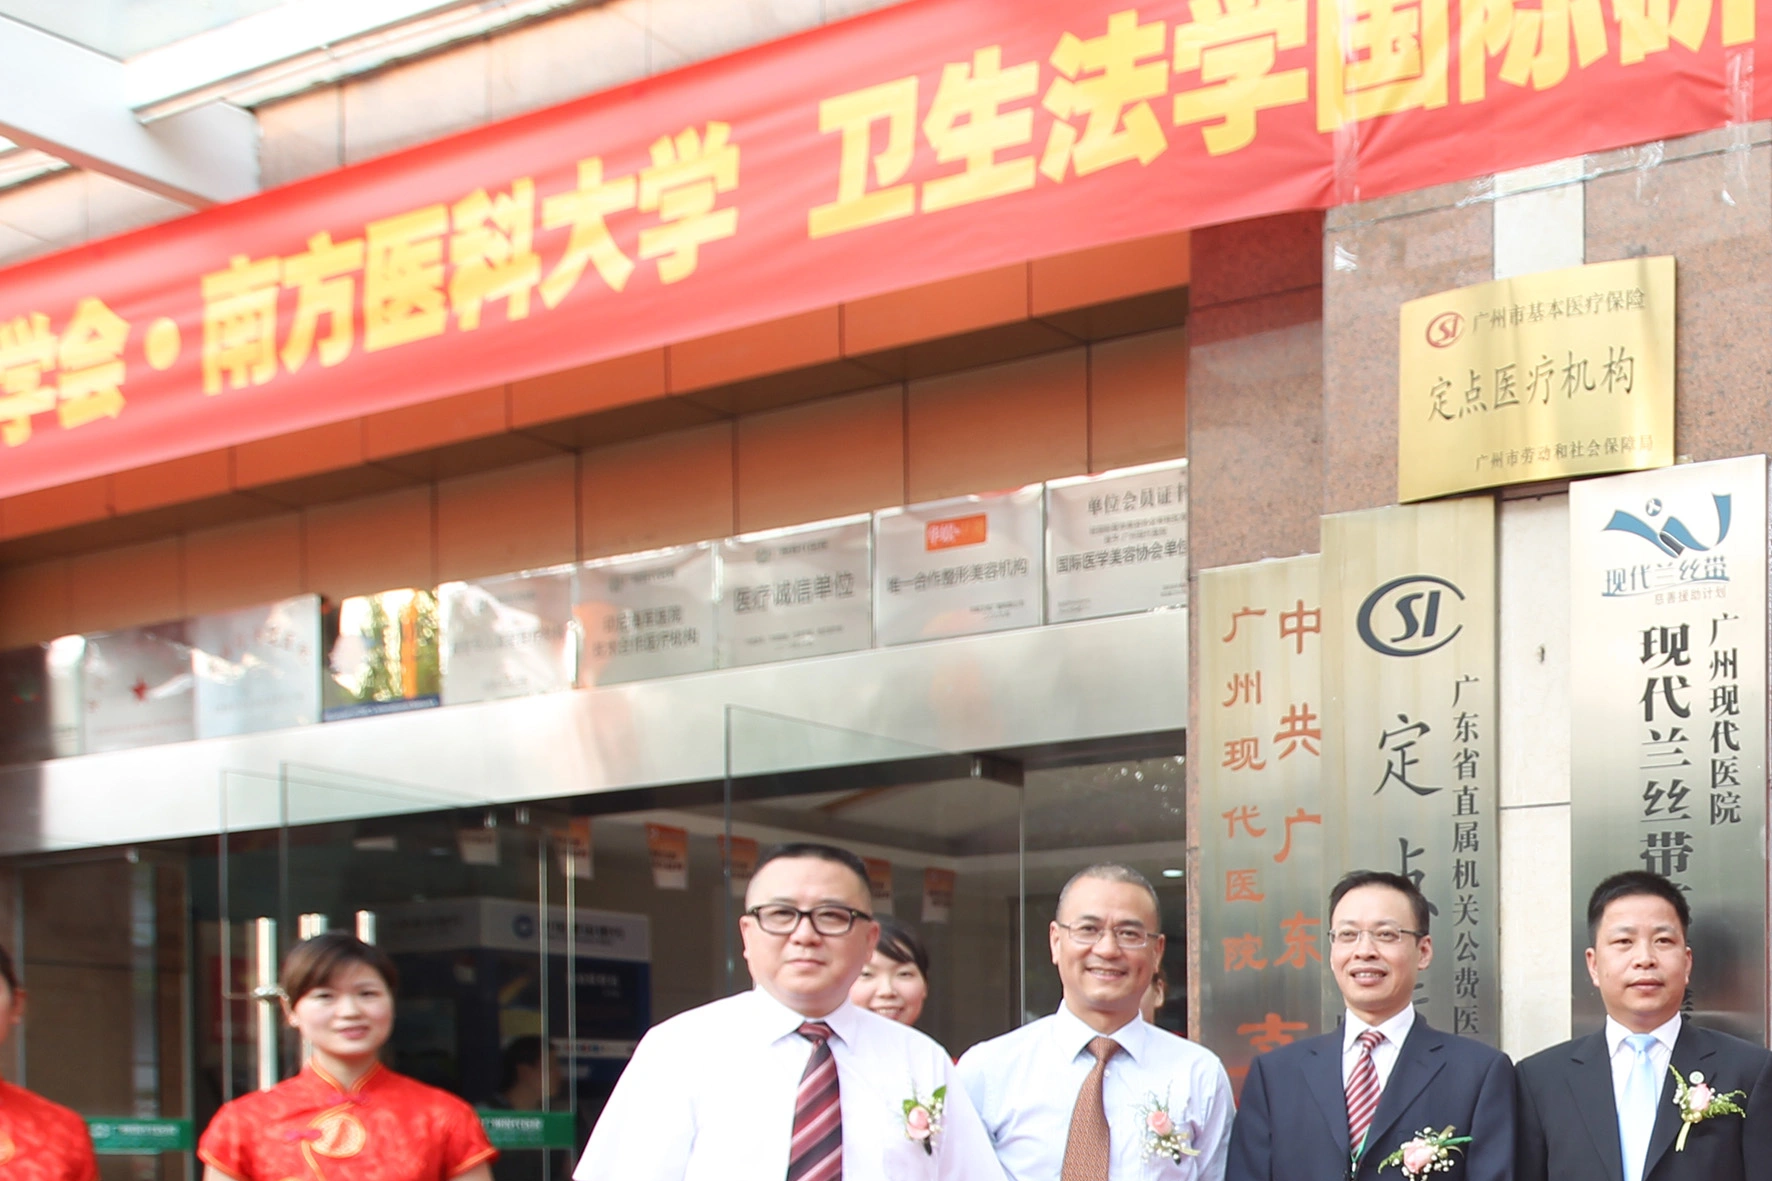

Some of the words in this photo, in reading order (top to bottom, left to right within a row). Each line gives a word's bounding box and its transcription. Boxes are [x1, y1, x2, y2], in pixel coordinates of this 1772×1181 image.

[1472, 287, 1646, 334] 广州市基本医疗保险
[1427, 345, 1635, 422] 定点医疗机构
[1475, 433, 1654, 471] 广州市劳动和社会保障局
[1708, 612, 1742, 826] 广州现代医院
[1221, 606, 1268, 972] 广州现代医院
